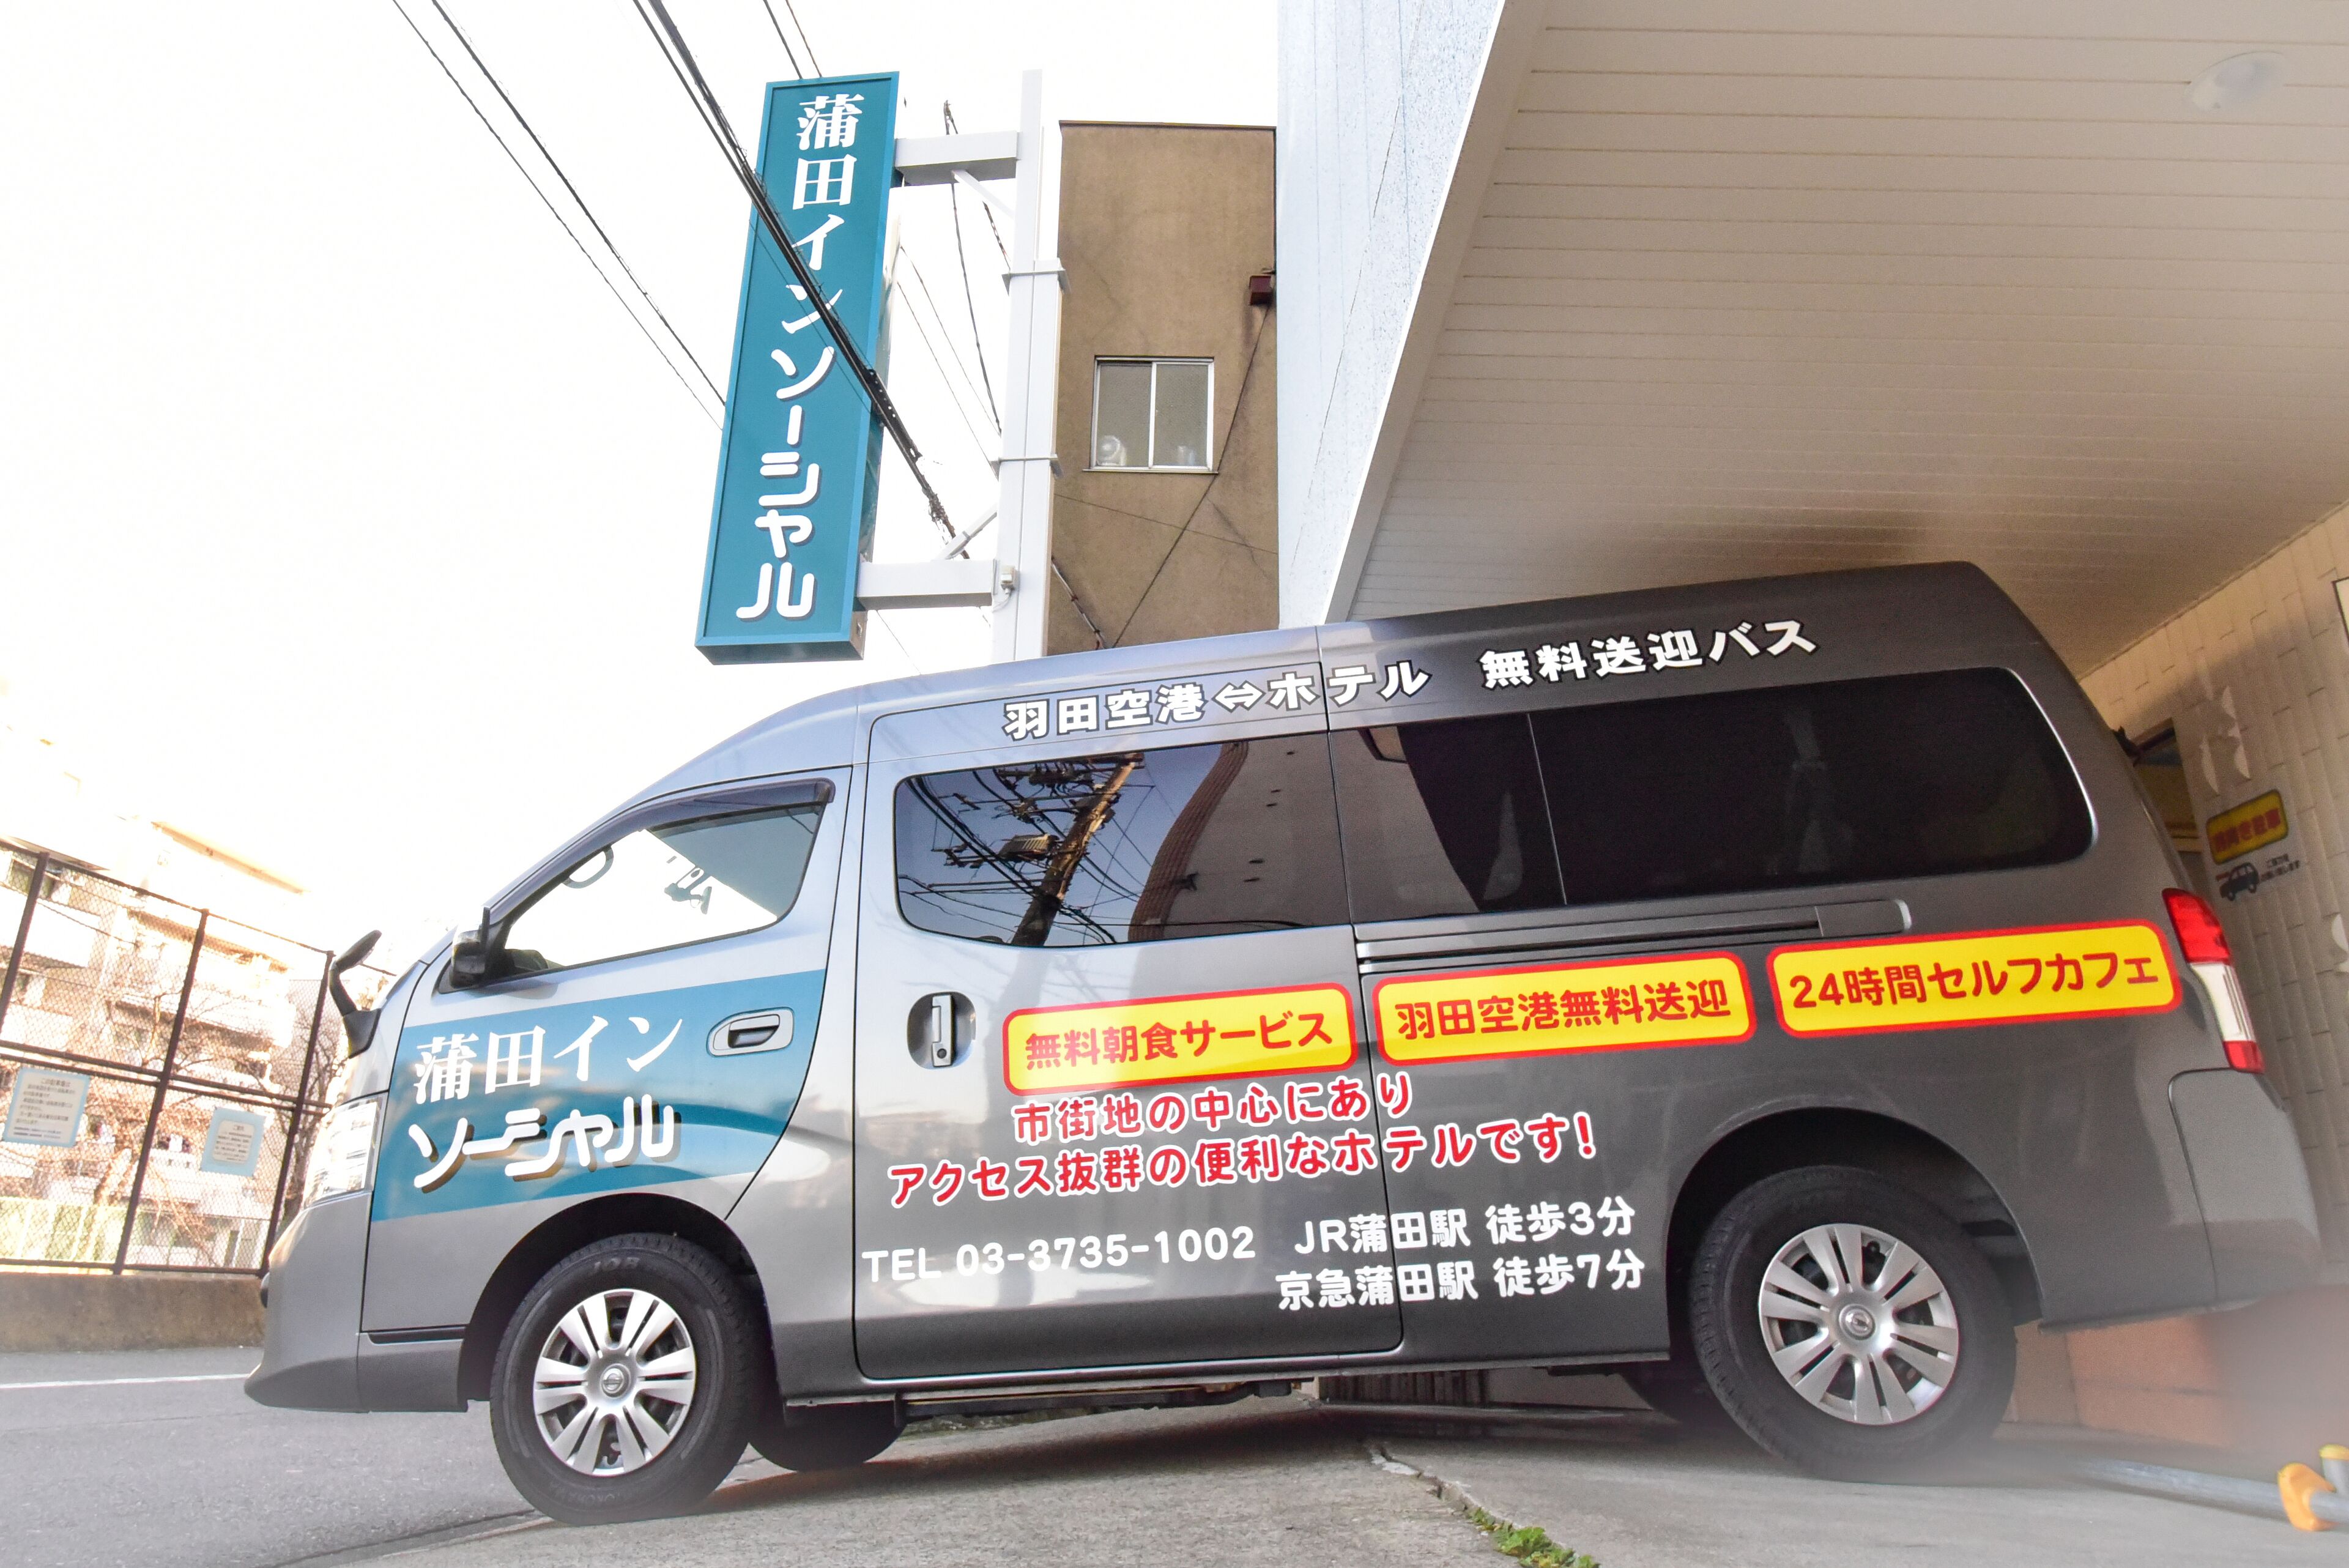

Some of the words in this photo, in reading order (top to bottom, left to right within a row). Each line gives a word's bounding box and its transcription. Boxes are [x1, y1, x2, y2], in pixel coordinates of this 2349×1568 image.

[736, 94, 864, 619] 蒲田インソーシャル
[1003, 683, 1208, 741] 羽田空港
[1265, 660, 1433, 711] ホテル
[1477, 619, 1819, 690] 無料送迎バス
[1395, 979, 1731, 1039] 羽田空港無料送迎
[1789, 951, 2159, 1009] 24時間セルフカフェ
[414, 1015, 683, 1105] 蒲田イン
[1025, 1010, 1332, 1071] 無料朝食サービス
[409, 1093, 675, 1191] ソーシャル
[1011, 1071, 1412, 1146] 市街地の中心にあり
[887, 1112, 1597, 1208] アクセス抜群の便利なホテルです!
[861, 1247, 942, 1282] TEL
[956, 1225, 1256, 1277] 03-3735-1002
[1294, 1208, 1471, 1255] JR蒲田駅
[1485, 1196, 1636, 1245] 徒歩3分
[1275, 1260, 1479, 1311] 京急蒲田駅
[1493, 1248, 1645, 1298] 徒歩7分
